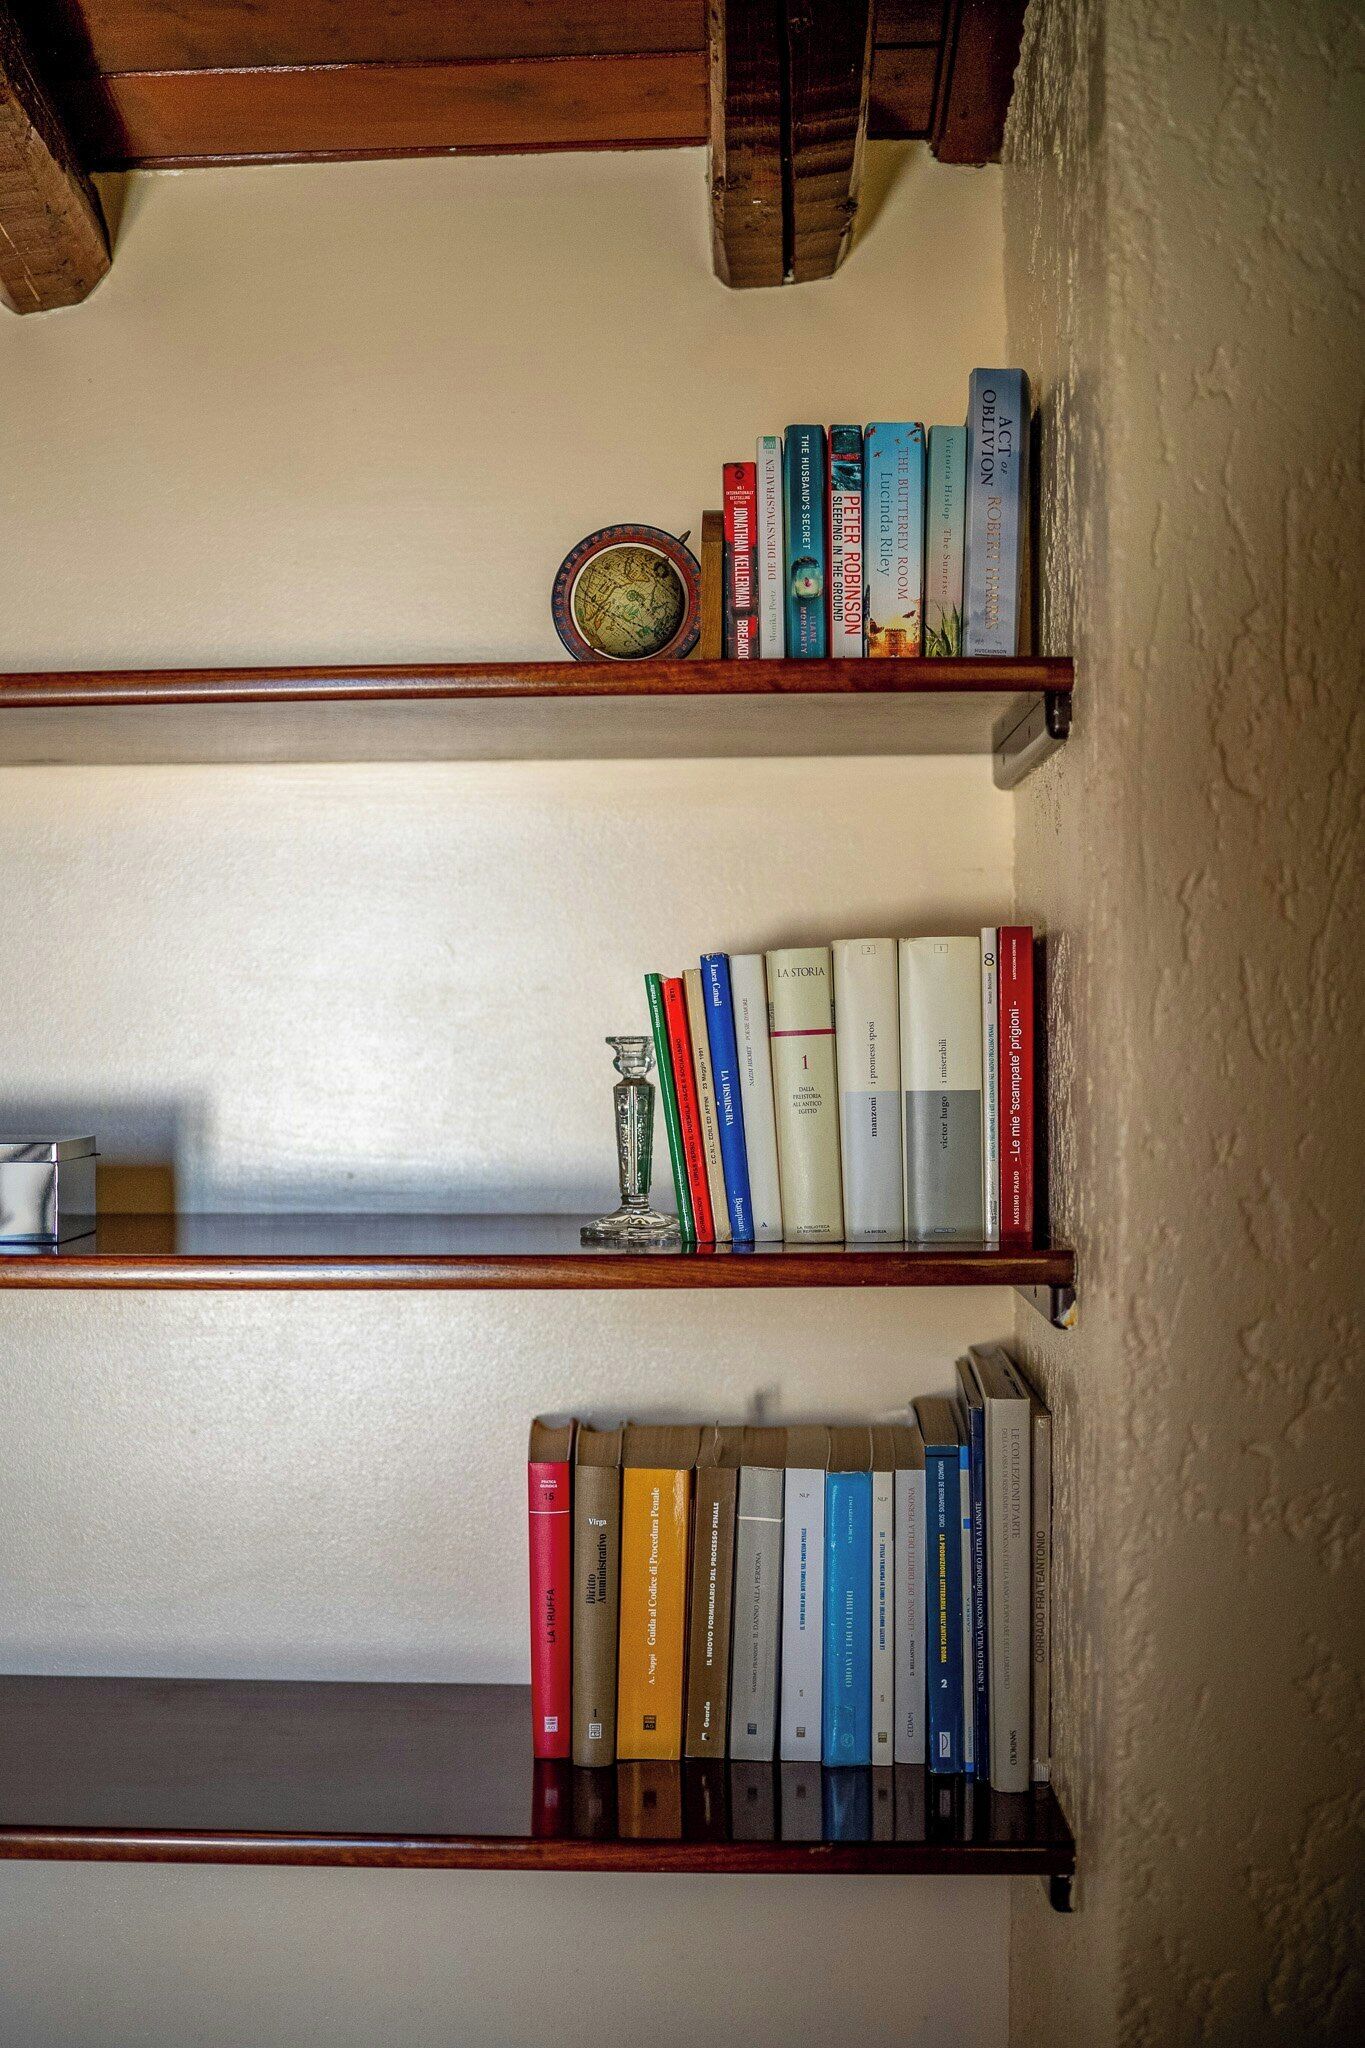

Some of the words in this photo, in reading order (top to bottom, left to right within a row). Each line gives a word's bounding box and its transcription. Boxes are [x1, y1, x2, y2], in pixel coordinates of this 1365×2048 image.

[801, 434, 810, 454] THE
[980, 389, 997, 487] OBLIVION
[997, 416, 1013, 458] ACT
[898, 447, 909, 474] THE
[945, 437, 953, 479] Victoria
[801, 457, 810, 511] HUSBAND'S
[766, 459, 776, 559] DIENSTAGSFRAUEN
[832, 496, 842, 541] SLEEPING
[880, 472, 893, 533] Lucinda
[897, 478, 909, 551] BUTTERFLY
[942, 485, 952, 520] Hislop
[733, 507, 749, 552] JONATHAN
[802, 513, 811, 550] SECRET
[843, 496, 860, 544] PETER
[986, 495, 1002, 560] ROBERT
[832, 545, 843, 555] IN
[943, 528, 951, 549] The
[767, 562, 776, 580] DIE
[832, 559, 843, 578] THE
[877, 538, 893, 577] Riley
[734, 554, 750, 608] KELLERMAN
[897, 557, 909, 600] ROOM
[941, 554, 951, 596] Sunrise
[832, 581, 843, 622] GROUND
[844, 552, 861, 635] ROBINSON
[984, 567, 1000, 630] HARRIS
[800, 606, 808, 654] MORIARTY
[809, 615, 817, 643] LIANE
[711, 964, 720, 981] Luca
[777, 968, 789, 978] LA
[791, 966, 826, 977] STORIA
[712, 982, 722, 1007] Canali
[866, 1021, 877, 1041] sposi
[1008, 1008, 1022, 1049] prigioni
[676, 1038, 687, 1079] SOCIALISMO
[802, 1054, 809, 1070] 1
[867, 1043, 878, 1079] promessi
[939, 1039, 947, 1078] miserabili
[702, 1082, 708, 1090] 23
[720, 1070, 730, 1082] LA
[705, 1116, 712, 1125] ED
[722, 1083, 734, 1126] DISMISURA
[868, 1096, 878, 1137] manzoni
[940, 1095, 949, 1119] hugo
[940, 1122, 948, 1150] victor
[1009, 1116, 1020, 1137] mie
[1009, 1140, 1020, 1154] Le
[735, 1197, 746, 1232] Bompiani
[1011, 1428, 1020, 1441] LE
[1011, 1441, 1020, 1501] COLLEZIONI
[543, 1492, 555, 1500] 15
[650, 1487, 660, 1517] Penale
[588, 1518, 607, 1527] Virga
[907, 1524, 915, 1549] DELLA
[1011, 1503, 1020, 1539] D'ARTE
[649, 1519, 659, 1565] Procedura
[710, 1530, 718, 1567] PROCESSO
[596, 1533, 607, 1604] Amministrativo
[648, 1566, 658, 1575] di
[754, 1552, 762, 1584] PERSONA
[907, 1552, 915, 1580] DIRITTI
[1034, 1530, 1045, 1610] FRATEANTONIO
[586, 1573, 596, 1604] Diritto
[647, 1576, 657, 1607] Codice
[546, 1588, 556, 1628] TRUFFA
[648, 1608, 656, 1617] al
[707, 1583, 715, 1630] FORMULARIO
[845, 1590, 854, 1629] DIRITTO
[907, 1599, 915, 1631] LESIONE
[976, 1597, 984, 1629] VISCONTI
[547, 1630, 556, 1644] LA
[646, 1618, 656, 1646] Guida
[752, 1631, 759, 1639] IL
[845, 1631, 854, 1648] DEL
[939, 1611, 947, 1645] NELL'ANTICA
[1035, 1611, 1045, 1664] CORRADO
[648, 1653, 658, 1675] Nappi
[845, 1652, 853, 1688] LAVORO
[977, 1650, 983, 1658] DI
[648, 1676, 656, 1685] A.
[941, 1679, 947, 1688] 2
